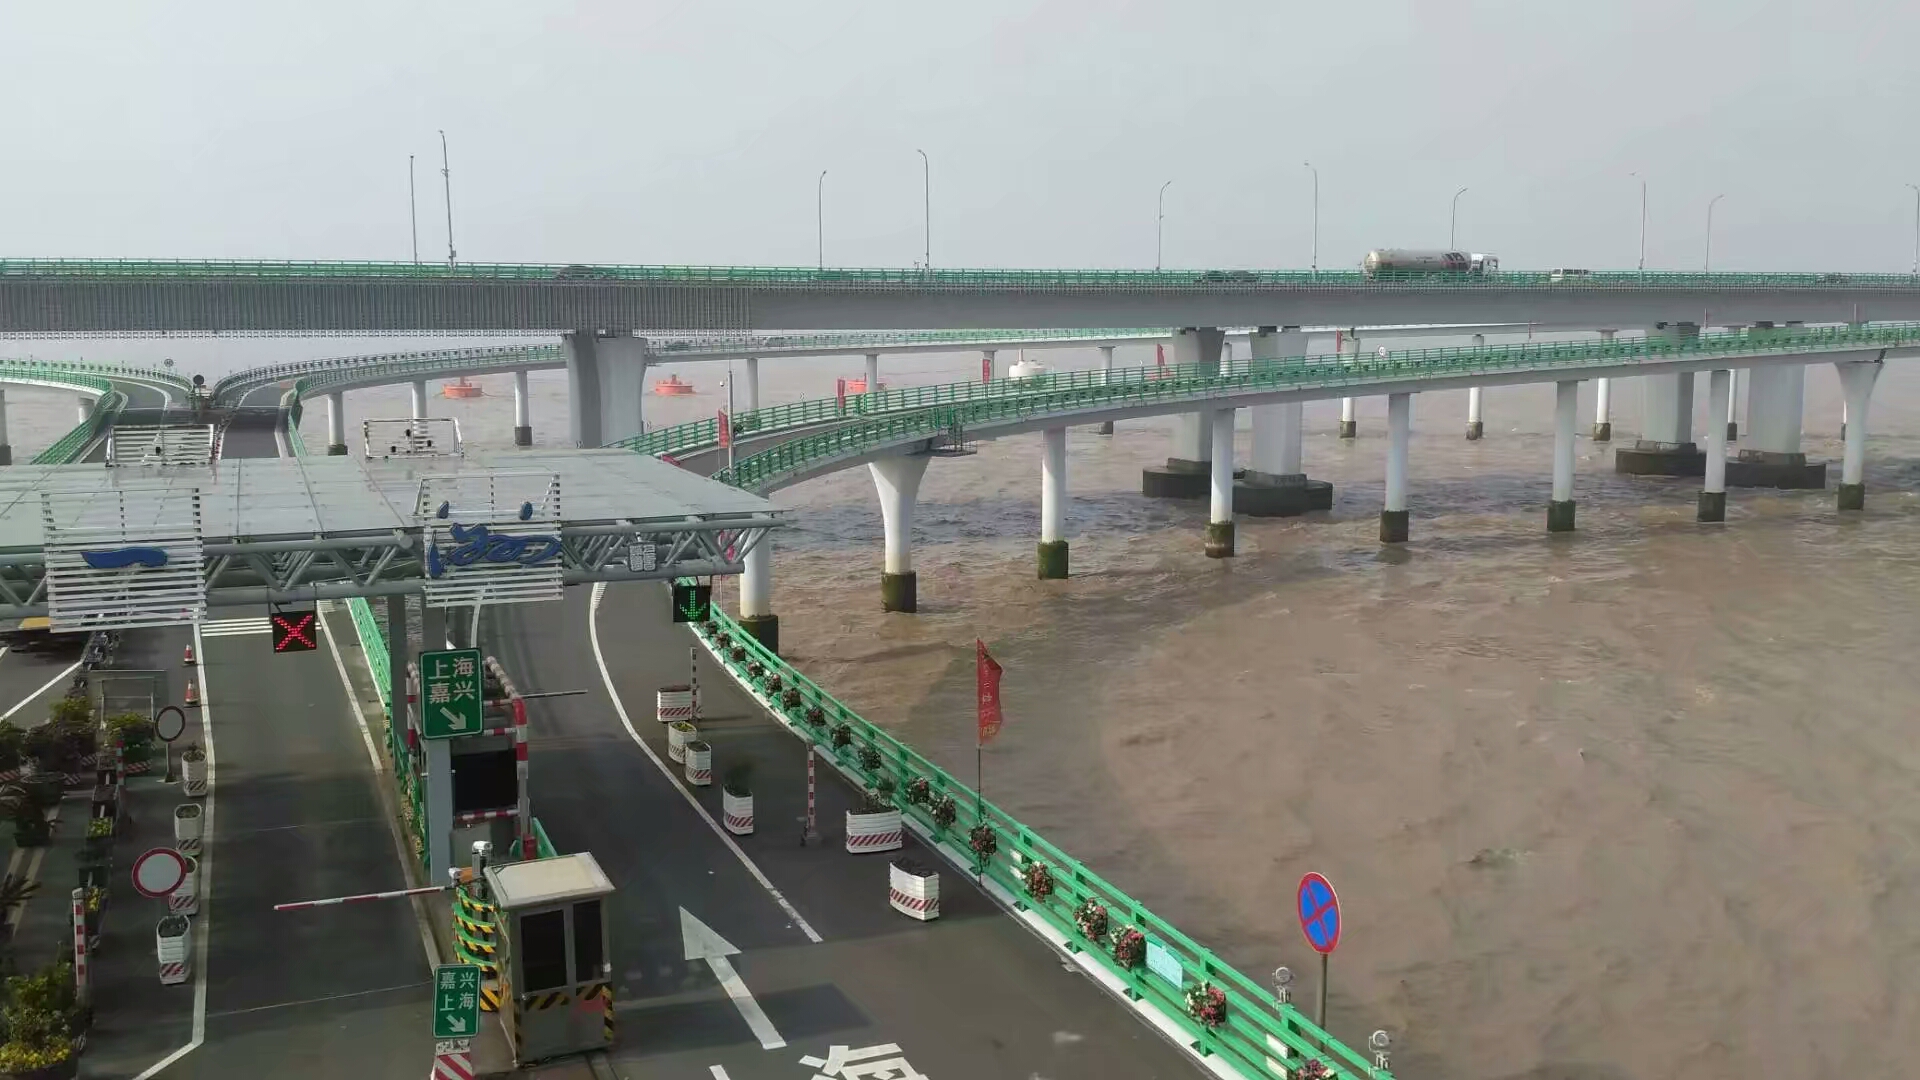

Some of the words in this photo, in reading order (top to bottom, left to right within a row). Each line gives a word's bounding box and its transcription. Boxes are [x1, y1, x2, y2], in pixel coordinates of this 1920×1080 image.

[428, 657, 474, 680] 上海
[428, 680, 475, 704] 嘉兴
[441, 972, 475, 989] 嘉兴
[441, 992, 475, 1011] 上海
